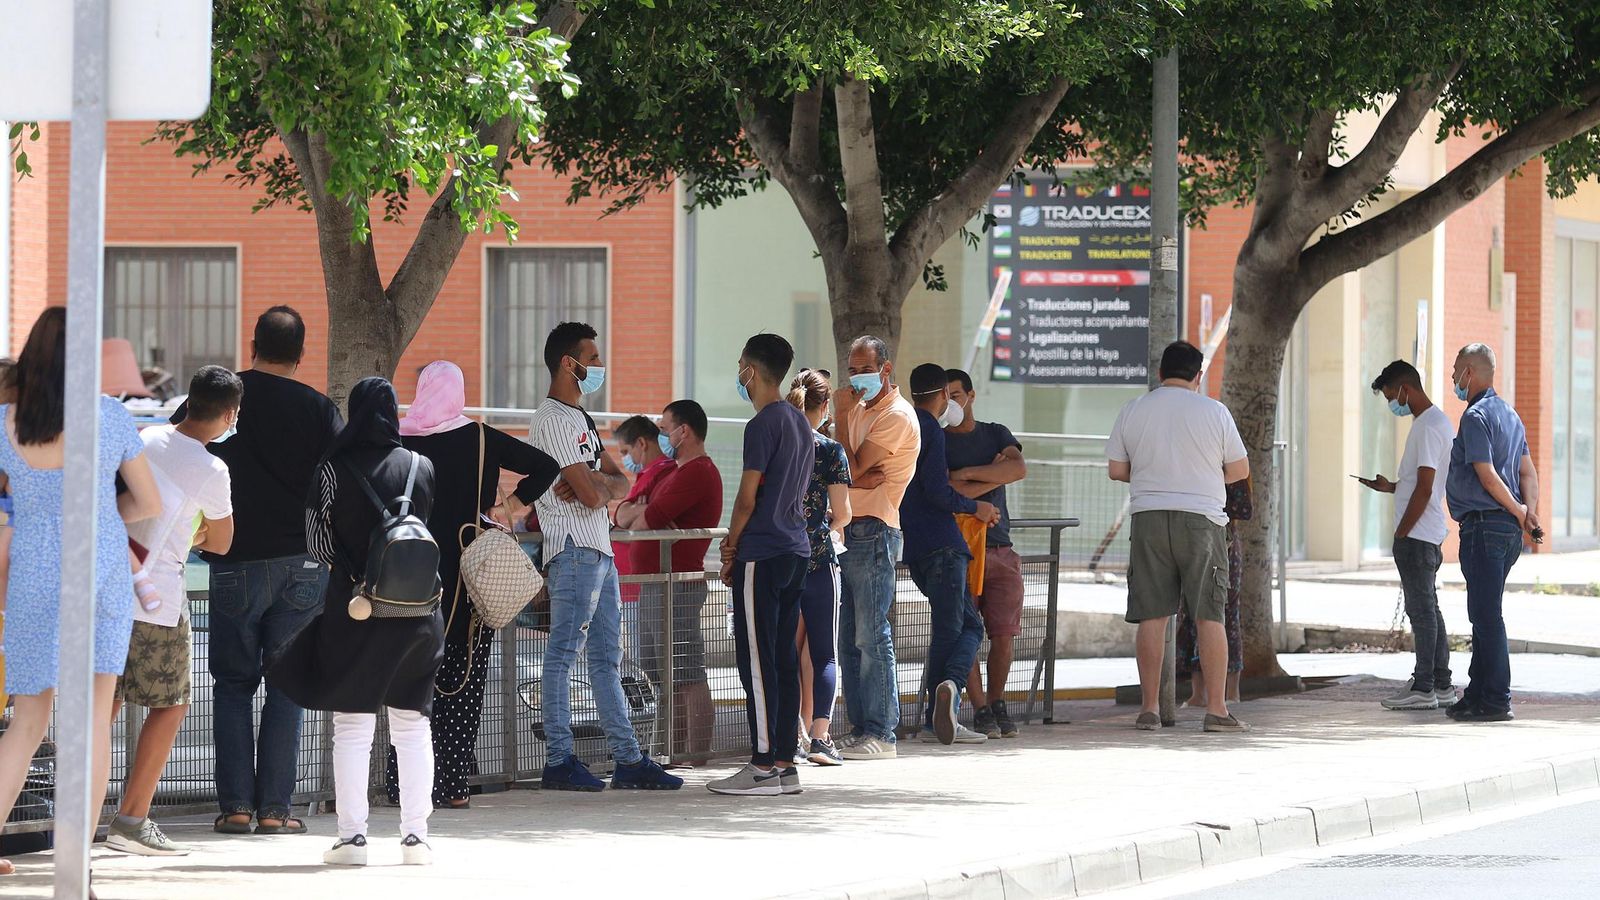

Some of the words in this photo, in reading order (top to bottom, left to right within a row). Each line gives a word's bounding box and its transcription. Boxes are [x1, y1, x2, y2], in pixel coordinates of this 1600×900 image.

[1041, 205, 1151, 220] TRADUCEX
[1019, 235, 1080, 246] TRADUCTIONS
[1024, 272, 1045, 284] A
[1050, 272, 1085, 284] 20
[1027, 298, 1092, 311] Traducciones
[1092, 298, 1130, 314] juradas
[1028, 315, 1083, 327] Traductores
[1085, 315, 1149, 330] acompañante
[1028, 331, 1099, 346] Legalizaciones
[1028, 347, 1069, 362] Apostilla
[1070, 347, 1084, 360] de
[1084, 347, 1094, 360] la
[1095, 348, 1119, 363] Haya
[1028, 364, 1097, 376] Asesoramiento
